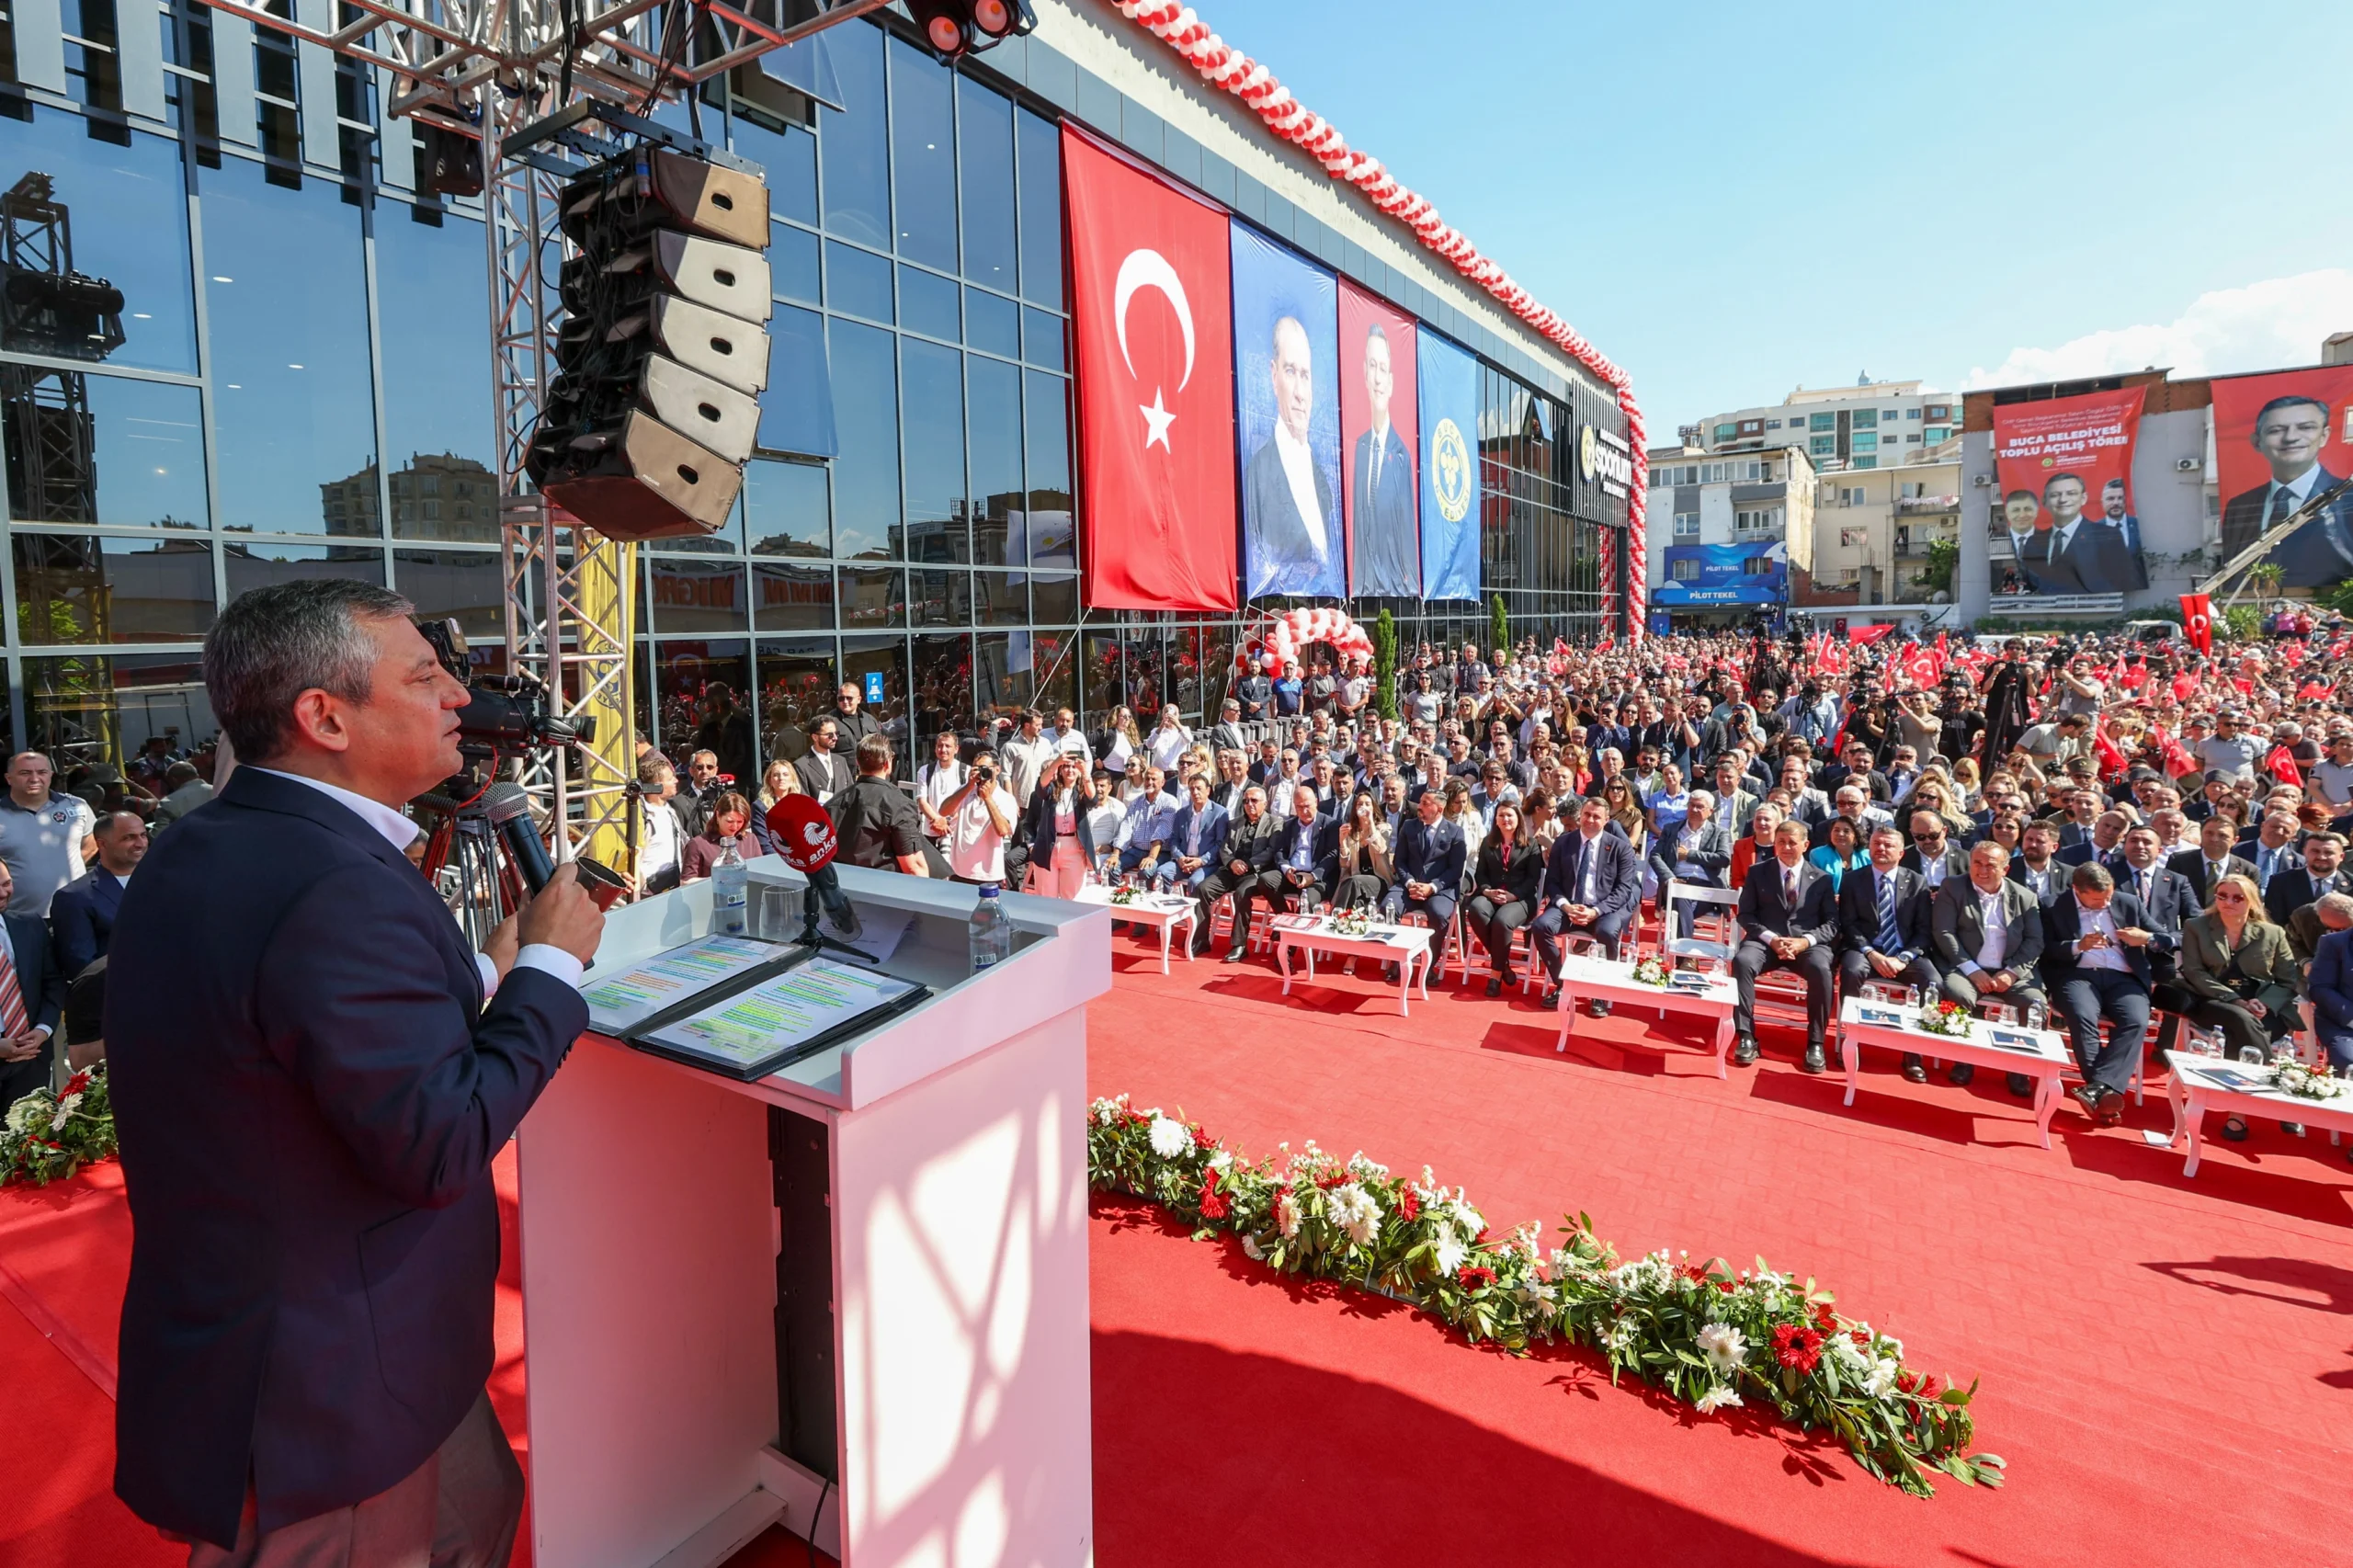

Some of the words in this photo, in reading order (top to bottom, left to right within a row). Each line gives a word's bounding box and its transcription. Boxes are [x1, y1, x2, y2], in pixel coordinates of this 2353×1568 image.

[2009, 435, 2045, 448] BUCA
[2048, 423, 2122, 442] BELEDİYESİ
[1999, 447, 2040, 459] TOPLU
[2043, 440, 2085, 455] AÇILIŞ
[1689, 590, 1712, 599] PİLOT
[810, 835, 836, 862] anka
